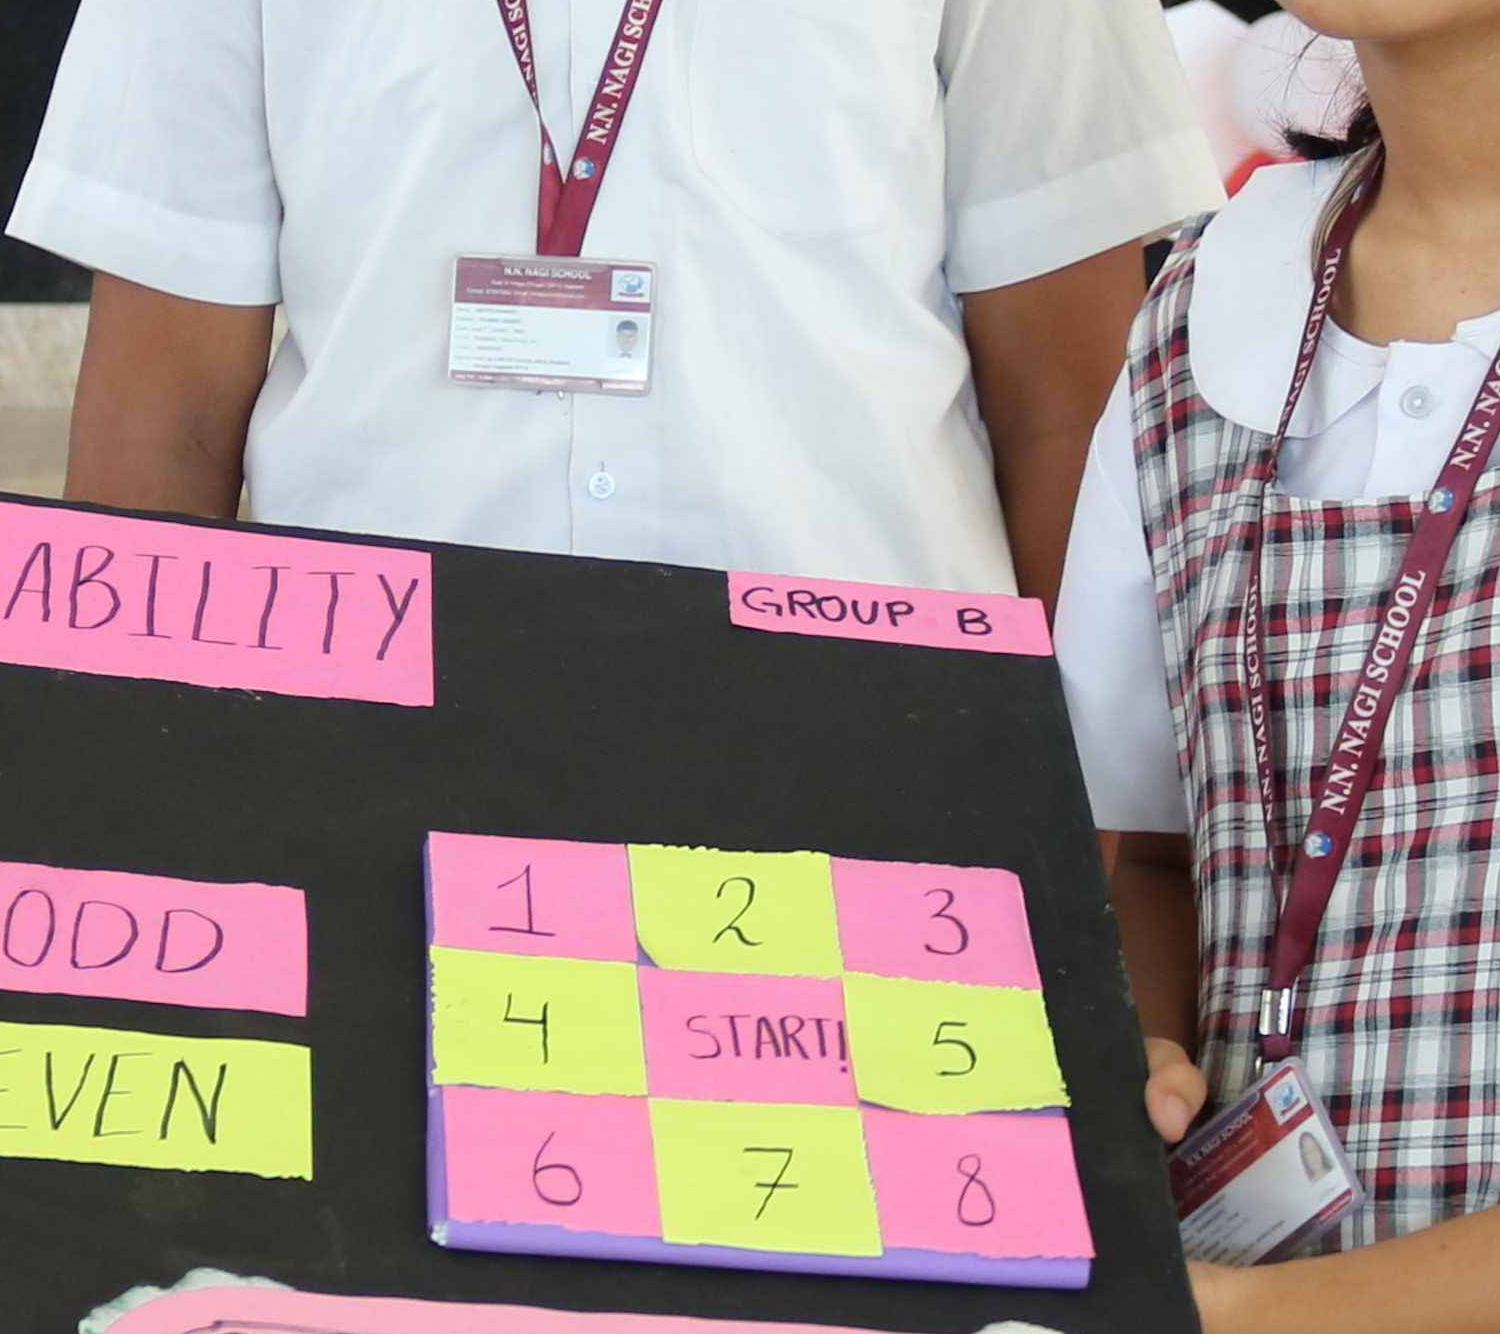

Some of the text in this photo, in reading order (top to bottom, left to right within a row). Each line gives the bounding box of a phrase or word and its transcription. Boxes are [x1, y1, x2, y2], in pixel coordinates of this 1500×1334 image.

[602, 40, 638, 99] NAGI
[1302, 248, 1342, 355] SCHOOL
[741, 586, 993, 636] GROUP B
[1339, 684, 1382, 758] NAGI
[1367, 569, 1426, 684] SCHOOL
[1, 887, 226, 976] ODD
[487, 864, 970, 957] 1 2 3
[503, 999, 979, 1077] 4 START! 5
[533, 1126, 997, 1227] 6 7 8
